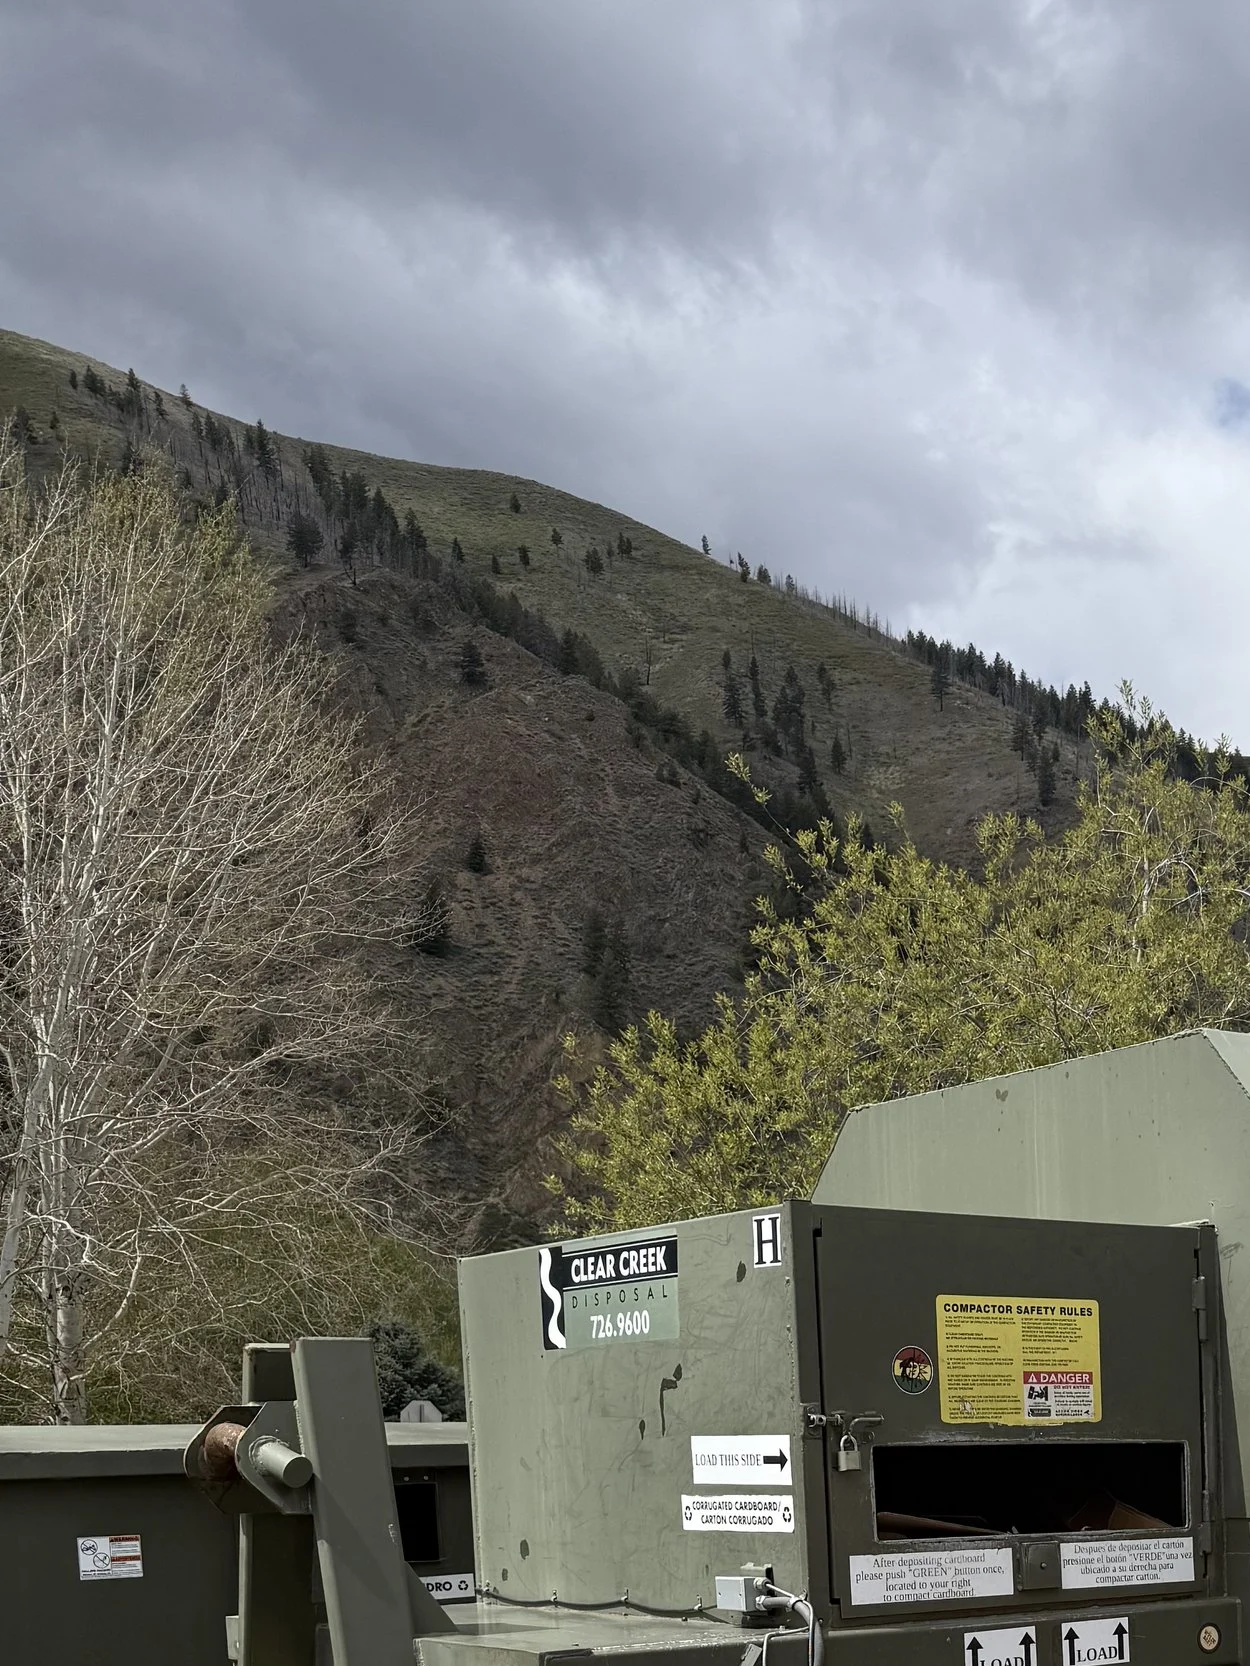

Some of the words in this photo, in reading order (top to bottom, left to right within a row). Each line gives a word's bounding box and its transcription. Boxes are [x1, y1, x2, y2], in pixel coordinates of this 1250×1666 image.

[754, 1217, 781, 1264] H
[571, 1255, 617, 1283] CLEAR
[619, 1245, 667, 1274] CREEK
[572, 1285, 668, 1309] DISPOSAL
[944, 1303, 1013, 1314] COMPACTOR
[1016, 1305, 1056, 1316] SAFETY
[1060, 1307, 1093, 1317] RULES
[590, 1310, 650, 1339] 726.9600
[1040, 1374, 1090, 1383] DANGER
[695, 1454, 717, 1466] LOAD
[720, 1454, 740, 1466] THIS
[741, 1454, 762, 1466] SIDE
[692, 1501, 733, 1511] CORRUGATED
[734, 1501, 781, 1512] CARDBOARD/
[729, 1516, 773, 1526] CORRUGADO
[1108, 1544, 1116, 1552] de
[1118, 1542, 1152, 1553] depositar
[1154, 1542, 1160, 1550] el
[872, 1558, 895, 1568] After
[898, 1556, 942, 1569] depositing
[944, 1554, 986, 1565] cardboard
[1063, 1557, 1095, 1568] presione
[1096, 1555, 1104, 1564] el
[856, 1571, 883, 1583] please
[886, 1570, 906, 1582] push
[954, 1566, 981, 1575] button
[983, 1566, 1005, 1575] once,
[1080, 1564, 1110, 1575] ubicado
[1129, 1562, 1157, 1572] derecha
[1159, 1563, 1174, 1571] para
[886, 1580, 917, 1592] located
[919, 1581, 927, 1589] to
[930, 1580, 949, 1591] your
[952, 1578, 971, 1590] right
[1096, 1574, 1134, 1584] compactar
[883, 1594, 891, 1602] to
[894, 1592, 930, 1601] compact
[1078, 1646, 1118, 1663] LOAD
